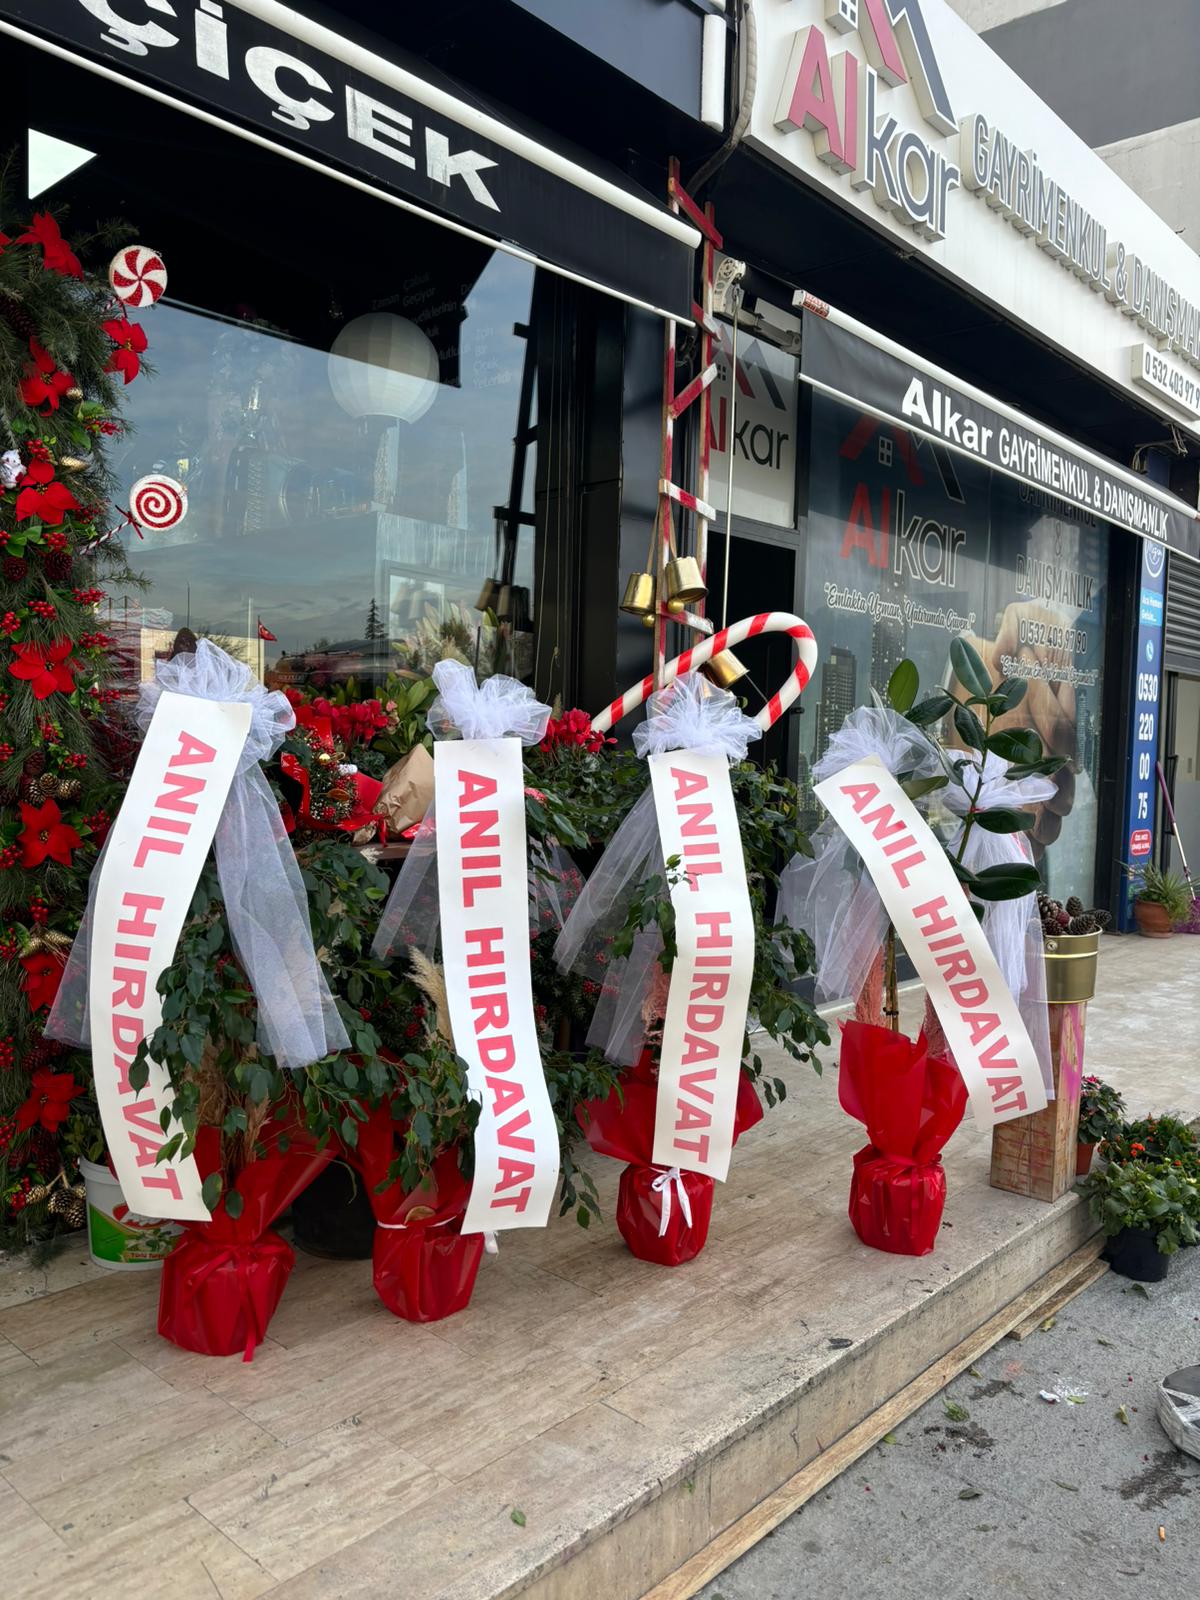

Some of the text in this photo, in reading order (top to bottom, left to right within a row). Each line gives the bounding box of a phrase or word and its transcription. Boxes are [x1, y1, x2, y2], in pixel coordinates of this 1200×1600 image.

[77, 0, 501, 213] ÇİÇEK
[786, 24, 960, 240] Alkar
[973, 112, 1111, 291] GAYRİMENKUL
[1115, 241, 1128, 305] &
[1152, 356, 1168, 387] 532
[1169, 369, 1184, 398] 403
[902, 376, 993, 456] Alkar
[999, 427, 1092, 504] GAYRİMENKUL
[1093, 475, 1101, 509] &
[1104, 480, 1168, 541] DANIŞMANLIK
[840, 481, 966, 588] Alkar
[1015, 553, 1094, 612] DANIŞMANLIK
[1028, 620, 1045, 646] 532
[1046, 626, 1063, 650] 403
[1138, 674, 1158, 701] 0530
[1139, 713, 1154, 741] 220
[1139, 752, 1150, 780] 00
[132, 730, 216, 868] ANIL
[1138, 792, 1148, 819] 75
[457, 769, 536, 1213] ANIL HIRDAVAT
[670, 767, 733, 1163] ANIL HIRDAVAT
[840, 782, 1028, 1114] ANIL HIRDAVAT
[111, 891, 183, 1200] HIRDAVAT
